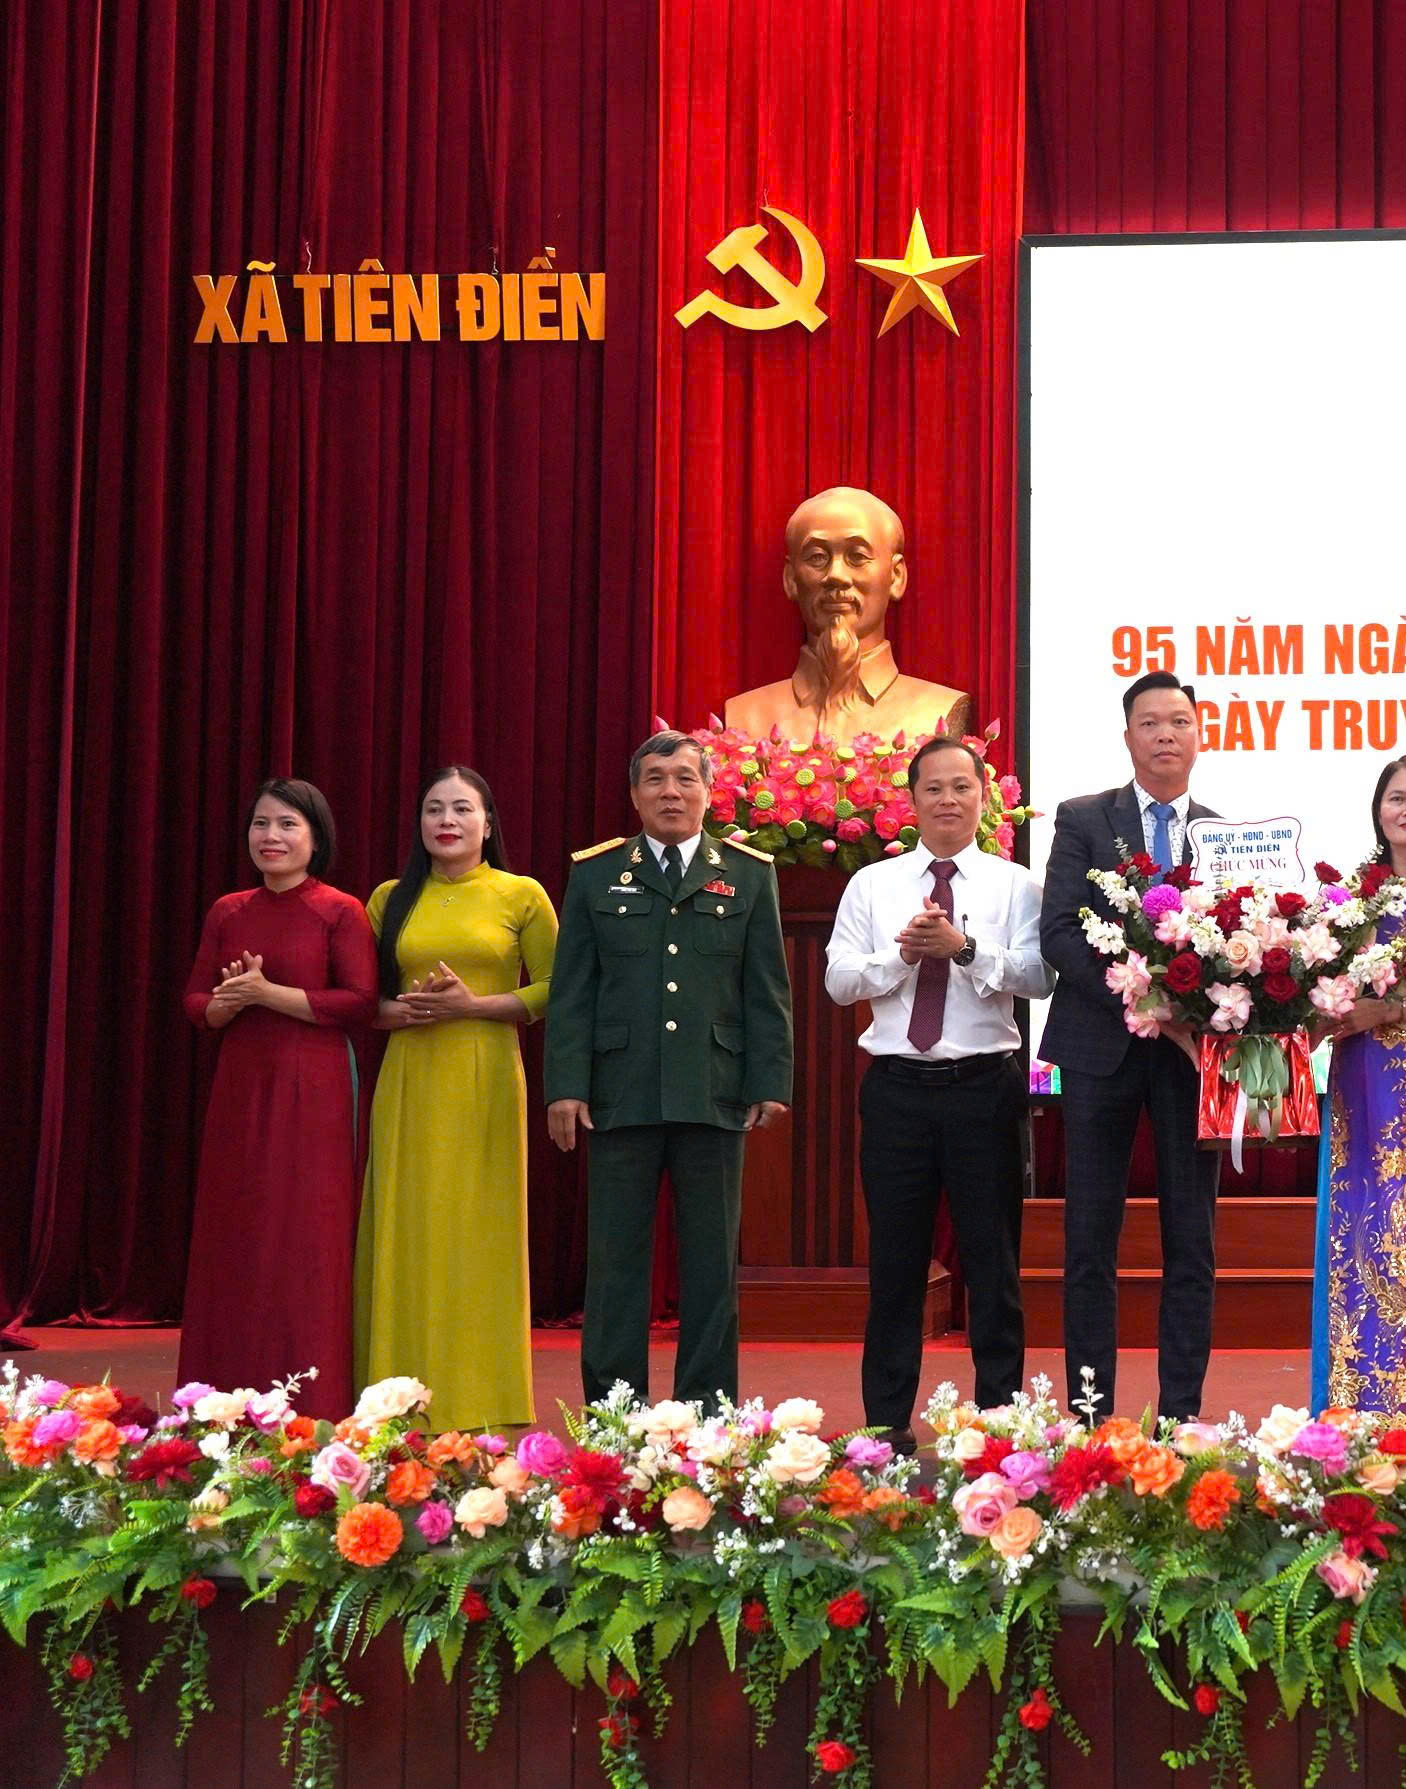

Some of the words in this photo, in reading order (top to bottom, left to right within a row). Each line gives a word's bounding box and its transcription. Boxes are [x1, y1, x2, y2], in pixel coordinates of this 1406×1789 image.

[194, 260, 288, 343] XÃ
[293, 258, 441, 343] TIÊN
[1111, 625, 1178, 678] 95
[1195, 616, 1304, 676] NĂM
[1196, 692, 1287, 754] GÀY
